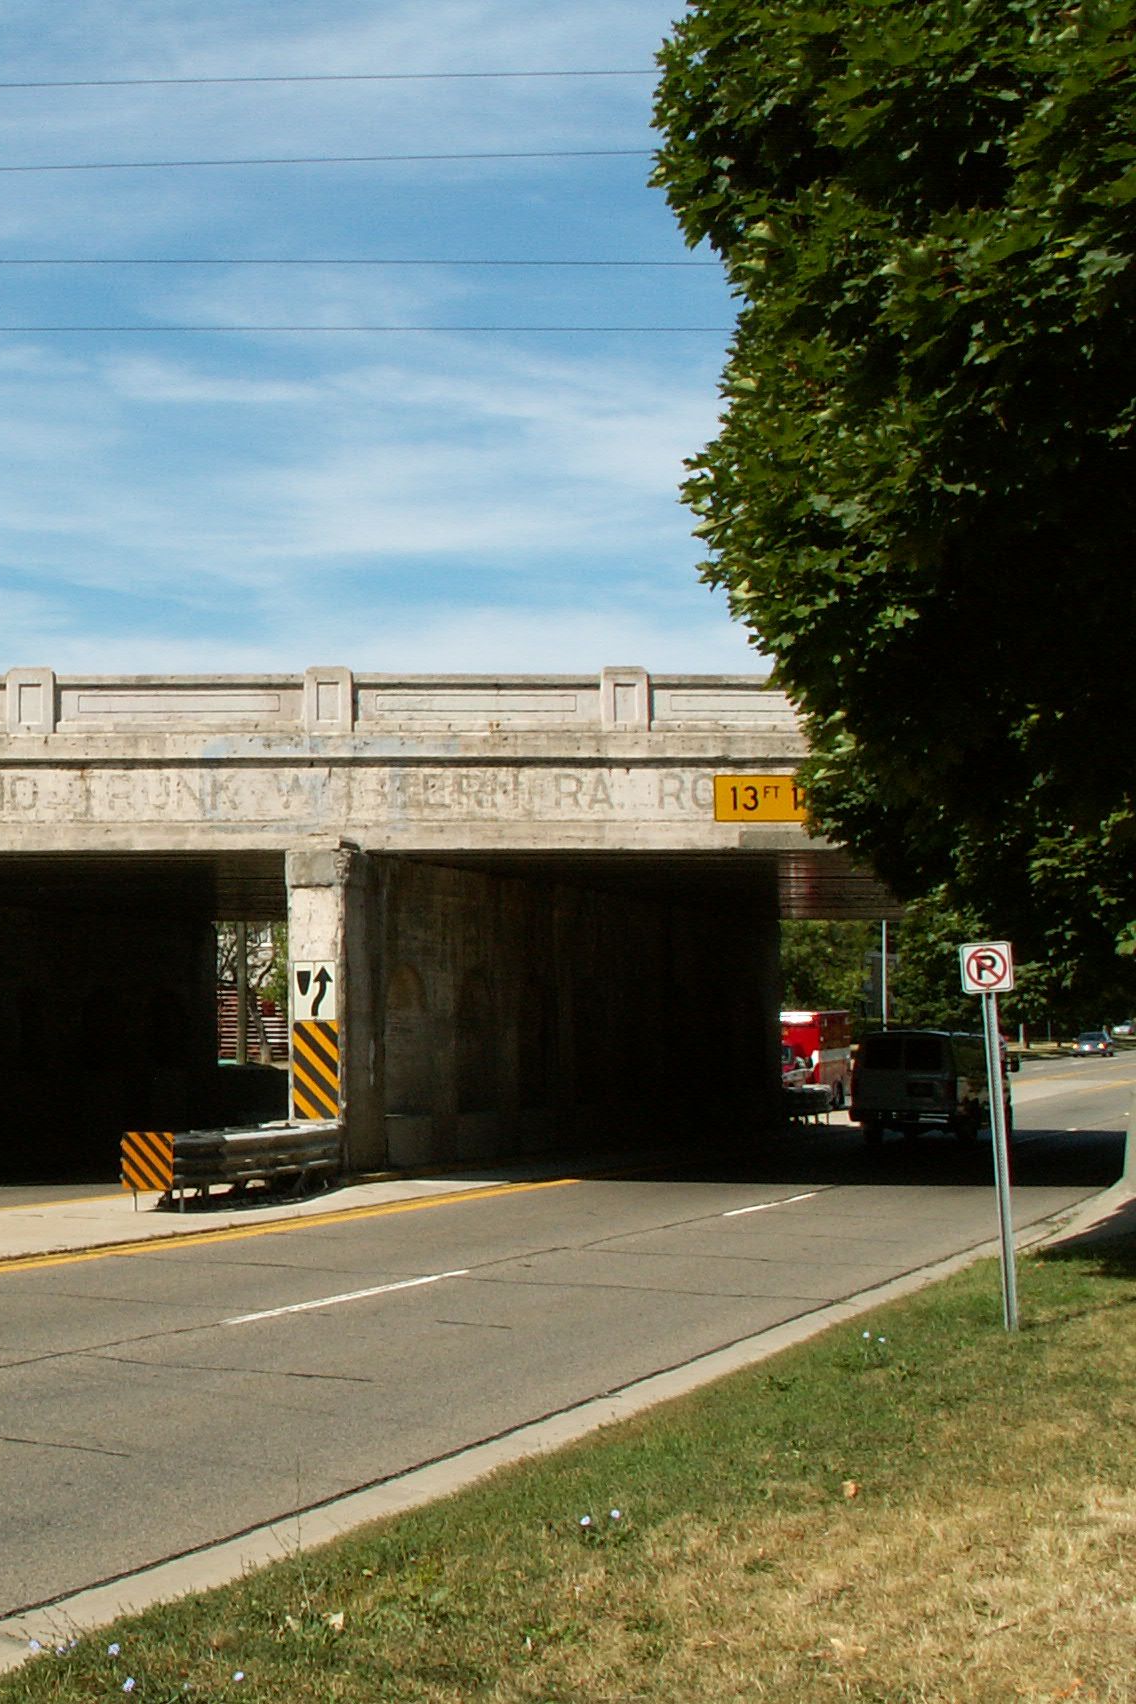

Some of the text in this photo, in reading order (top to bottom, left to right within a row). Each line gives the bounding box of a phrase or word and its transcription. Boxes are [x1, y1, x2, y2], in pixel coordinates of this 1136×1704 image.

[73, 773, 240, 812] TRUNK
[730, 785, 759, 811] 13
[763, 785, 781, 799] FT
